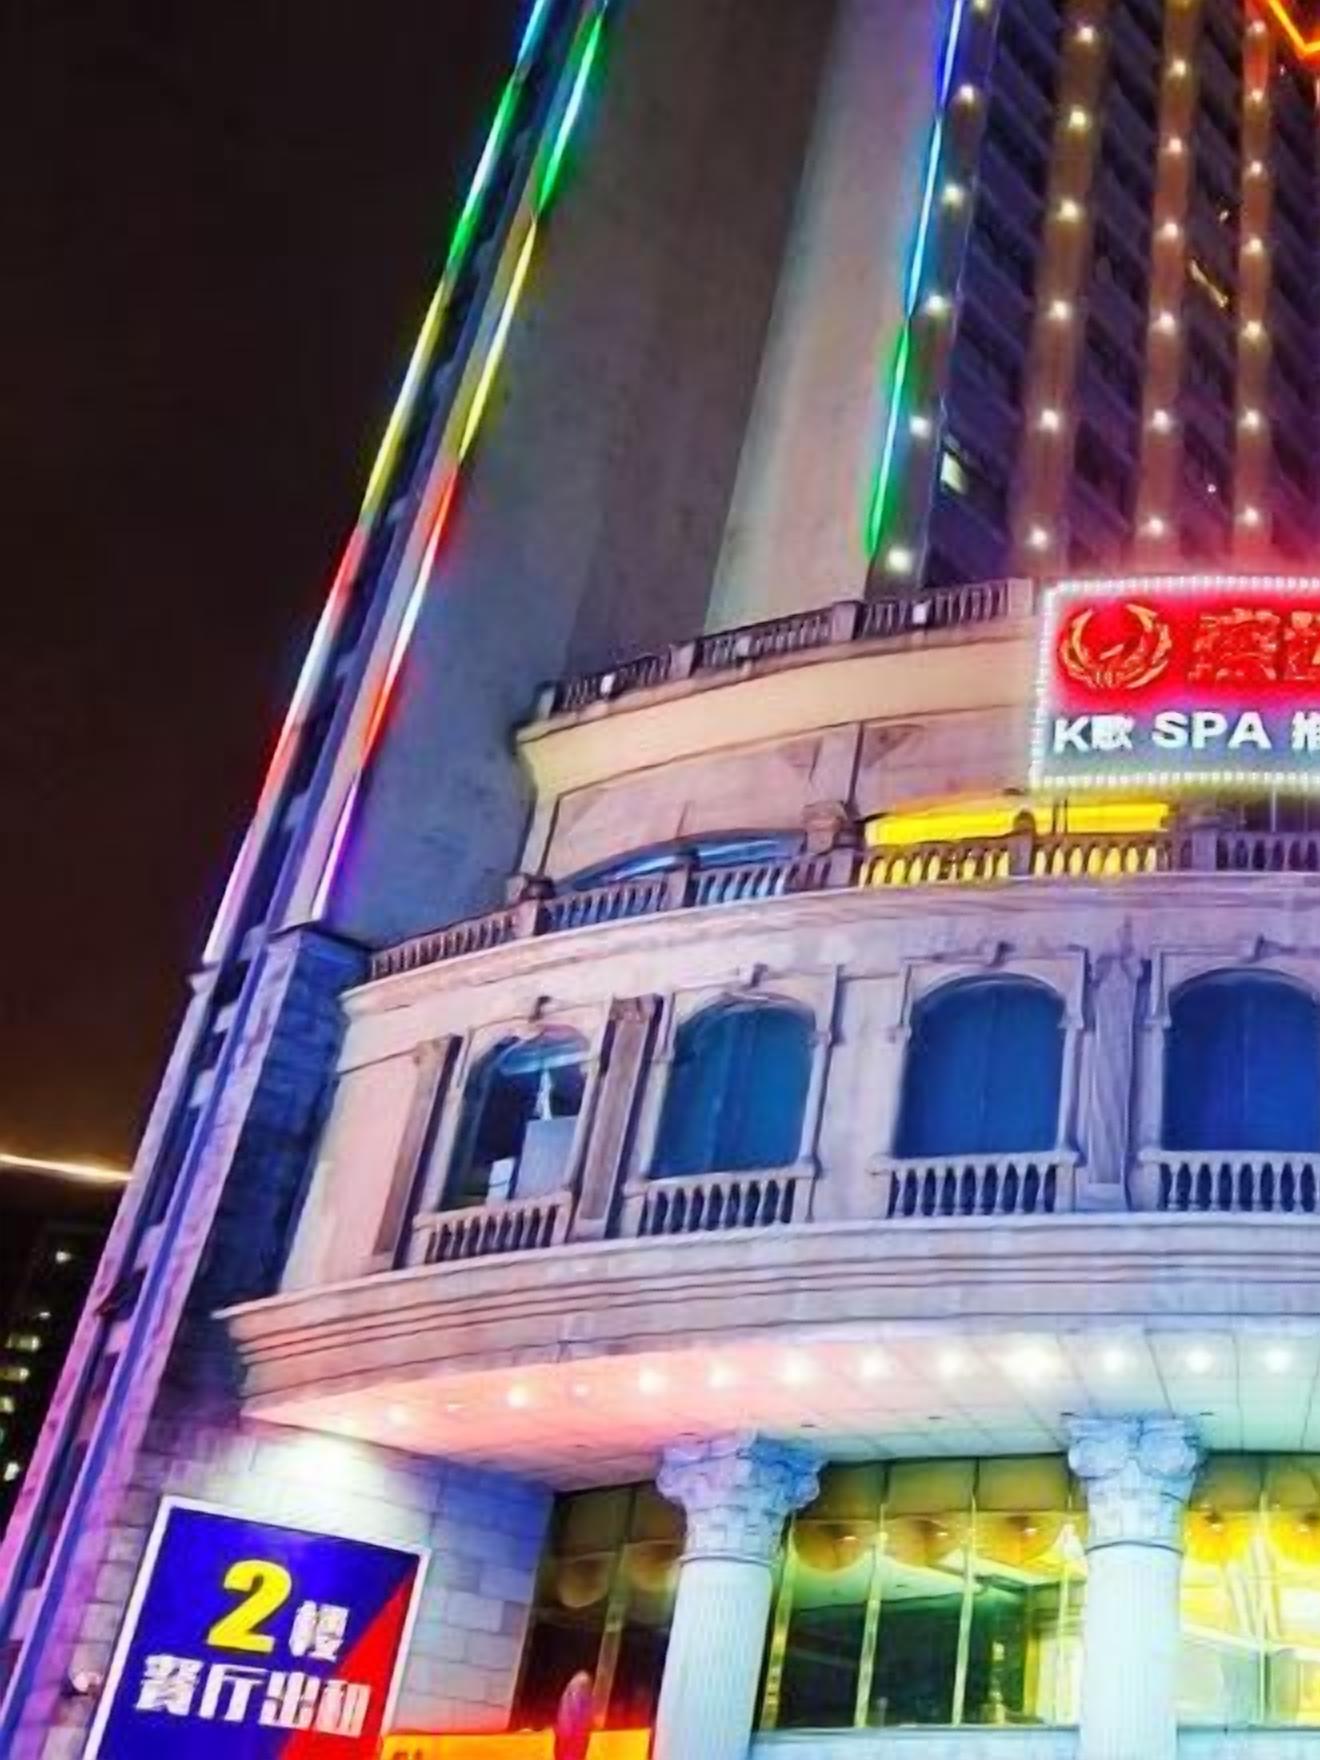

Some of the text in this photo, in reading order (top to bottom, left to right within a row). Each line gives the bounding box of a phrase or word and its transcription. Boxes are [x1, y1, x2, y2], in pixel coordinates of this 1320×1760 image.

[1053, 714, 1134, 753] K歌
[1151, 711, 1272, 750] SPA
[135, 1654, 371, 1738] 餐厅出租
